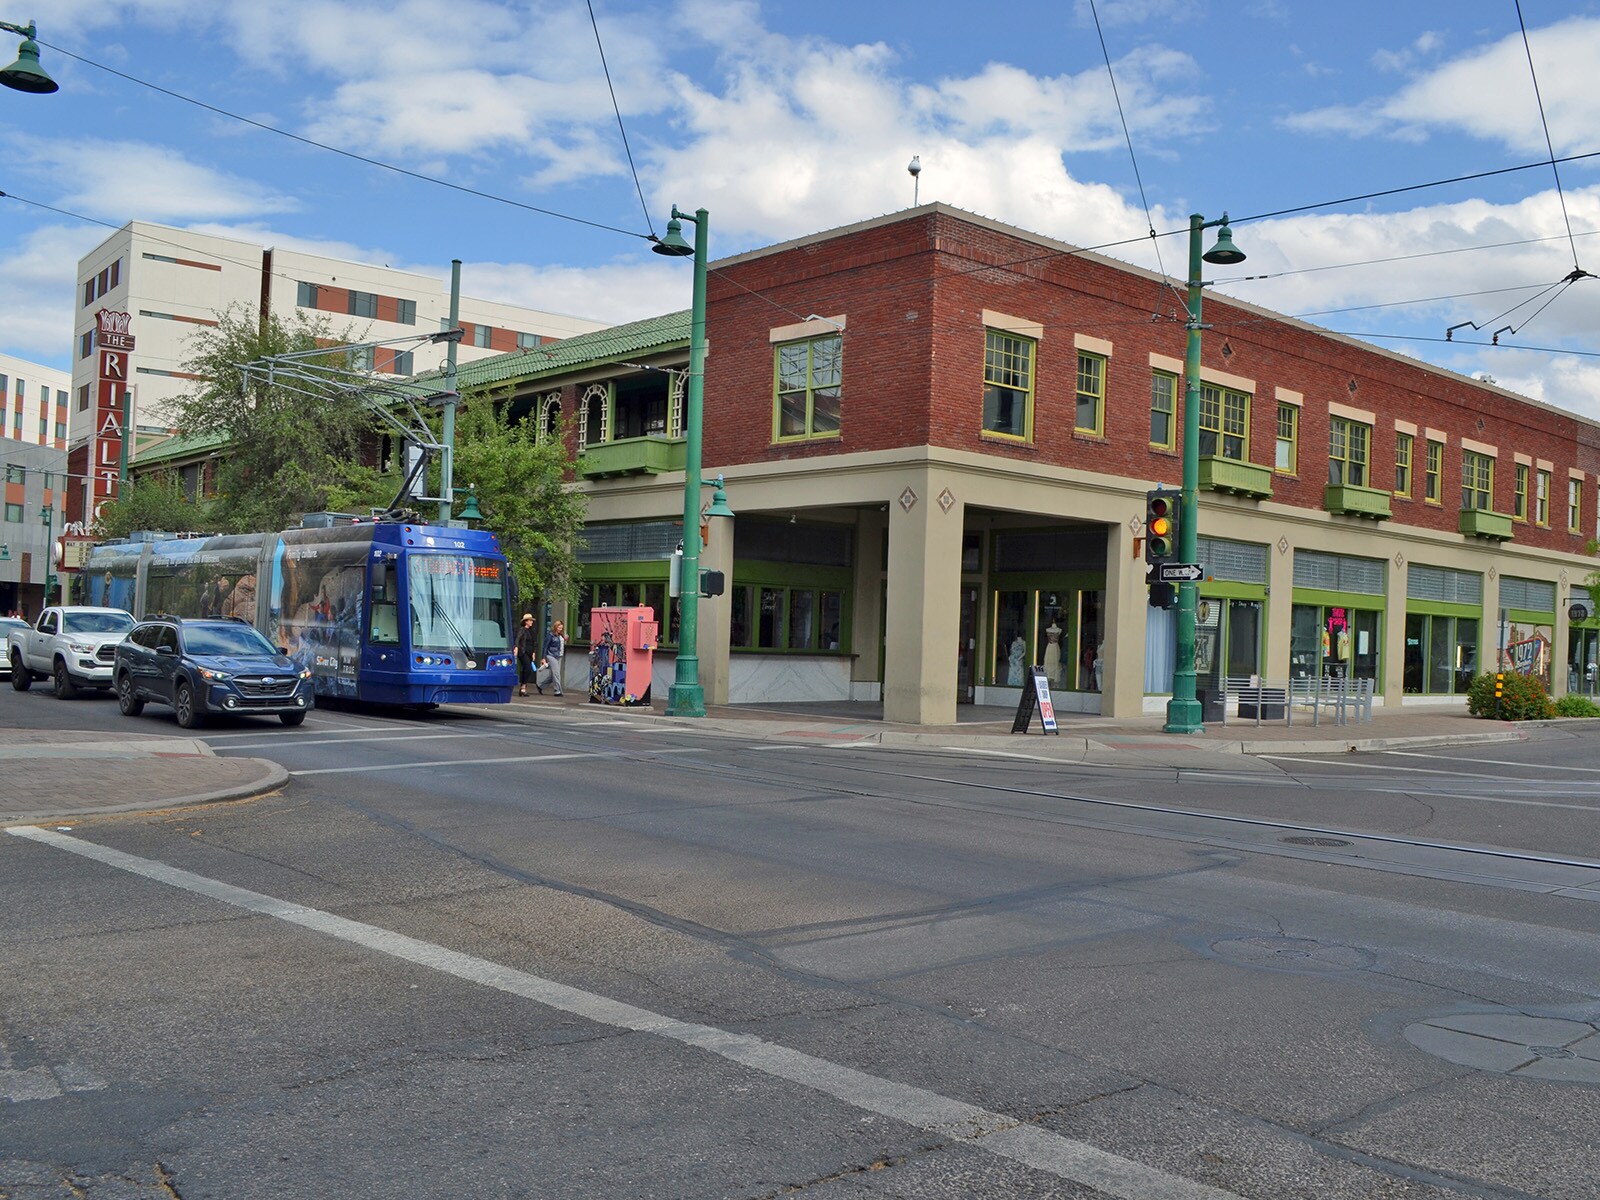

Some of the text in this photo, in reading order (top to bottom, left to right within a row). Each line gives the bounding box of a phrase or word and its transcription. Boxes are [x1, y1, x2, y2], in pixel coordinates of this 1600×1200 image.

[106, 334, 126, 346] THE
[453, 541, 465, 549] 102
[1164, 569, 1176, 577] ONE
